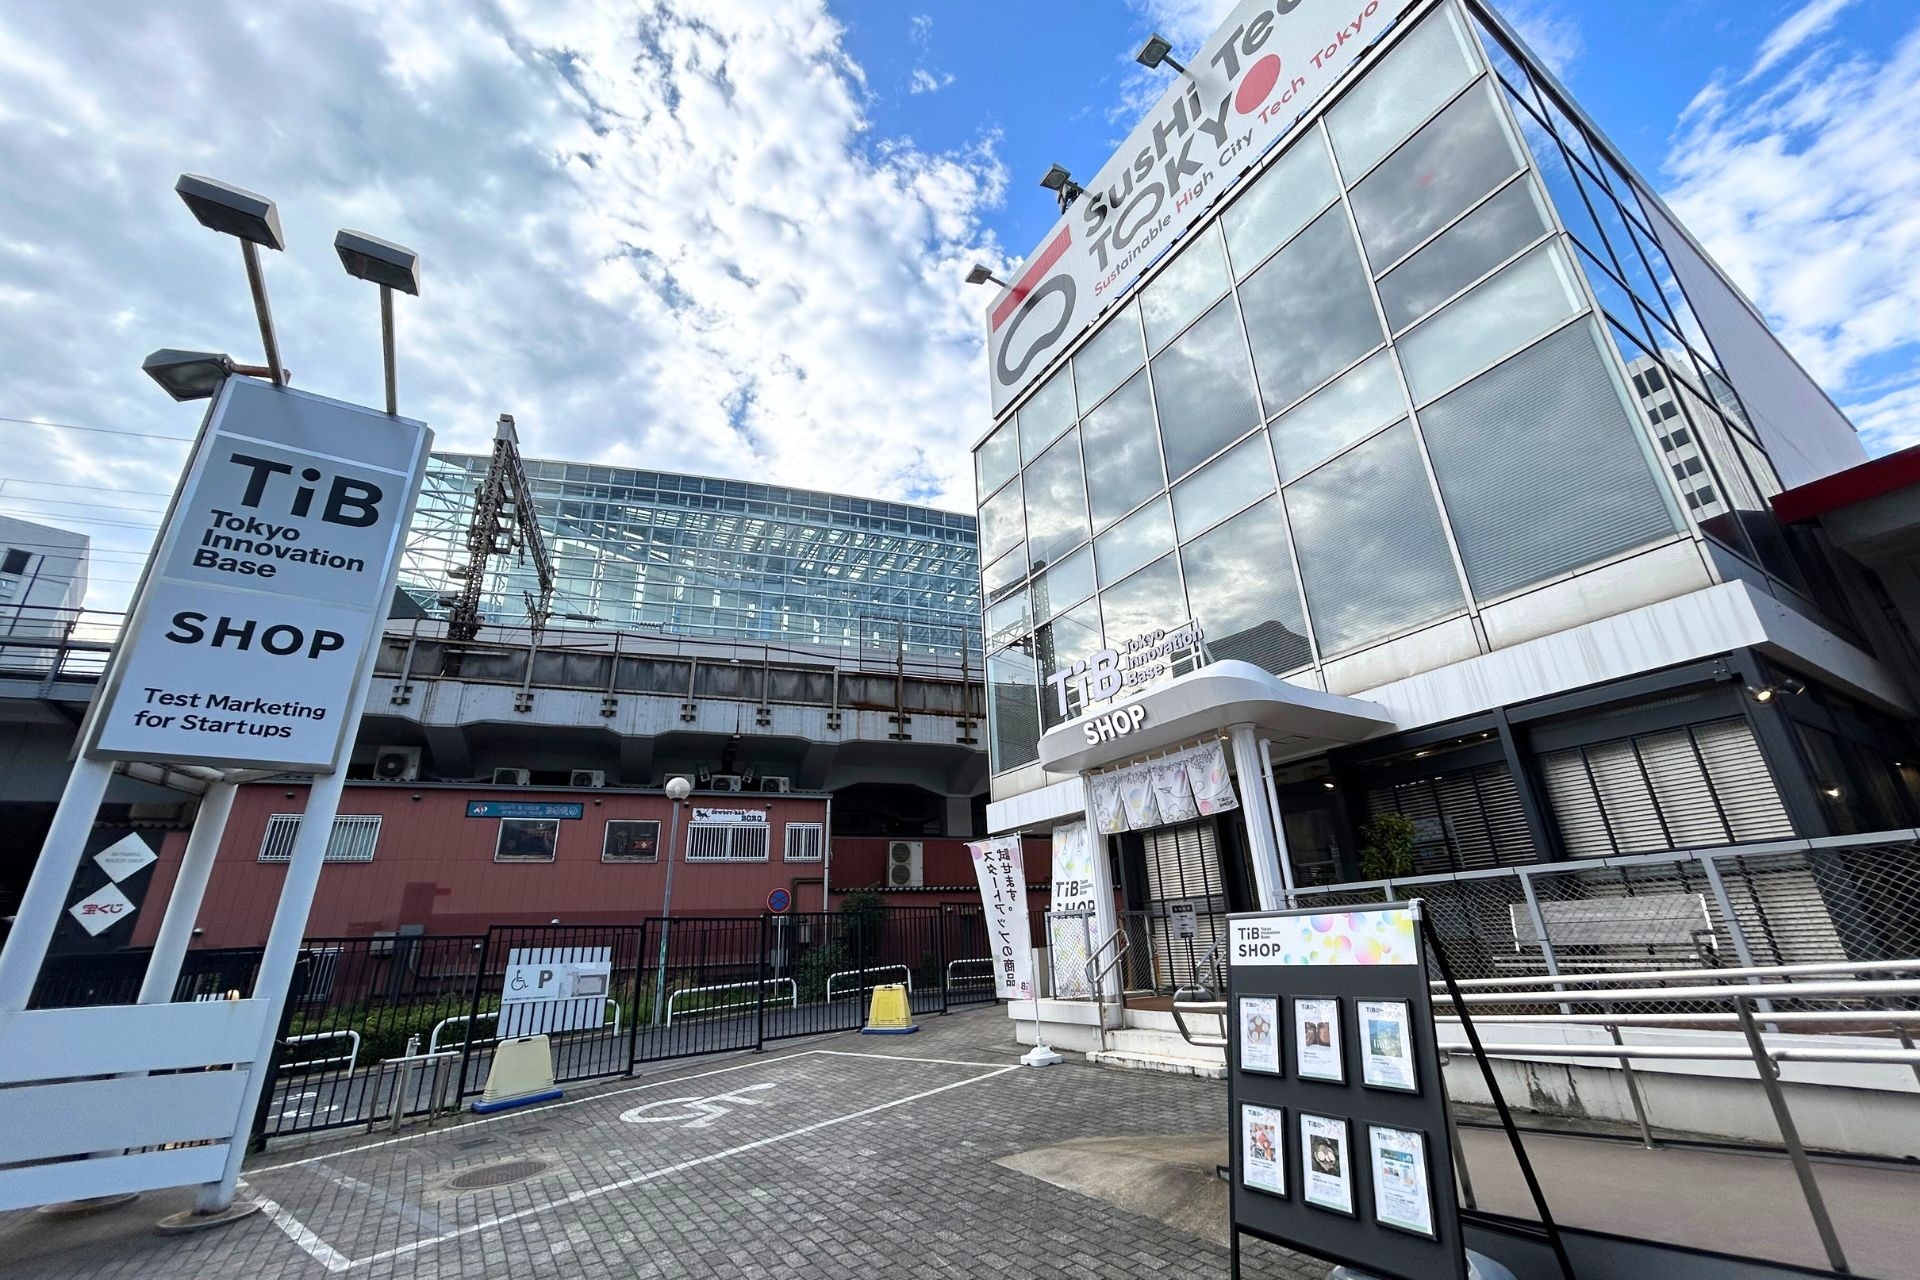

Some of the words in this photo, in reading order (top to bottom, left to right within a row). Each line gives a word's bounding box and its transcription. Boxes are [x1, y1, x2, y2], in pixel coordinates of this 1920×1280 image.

[1094, 214, 1171, 296] Sustainable
[1175, 170, 1214, 214] High
[1219, 128, 1253, 167] City
[1257, 76, 1305, 124] Tech
[1310, 0, 1378, 69] Tokyo
[230, 453, 383, 528] TiB
[210, 509, 300, 541] Tokyo
[192, 548, 276, 578] Base
[201, 528, 365, 573] Innovation
[164, 611, 345, 659] SHOP
[1123, 629, 1165, 654] Tokyo
[1126, 627, 1205, 670] Innovation
[1047, 648, 1122, 717] TiB
[1126, 663, 1165, 687] Base
[144, 687, 201, 708] Test
[205, 694, 326, 720] Marketing
[134, 710, 175, 728] for
[179, 714, 292, 738] Startups
[1082, 705, 1145, 745] SHOP
[1056, 880, 1079, 897] TiB
[82, 903, 123, 915] 宝くじ
[1237, 927, 1260, 940] TiB
[1238, 943, 1281, 957] SHOP
[538, 969, 553, 988] P
